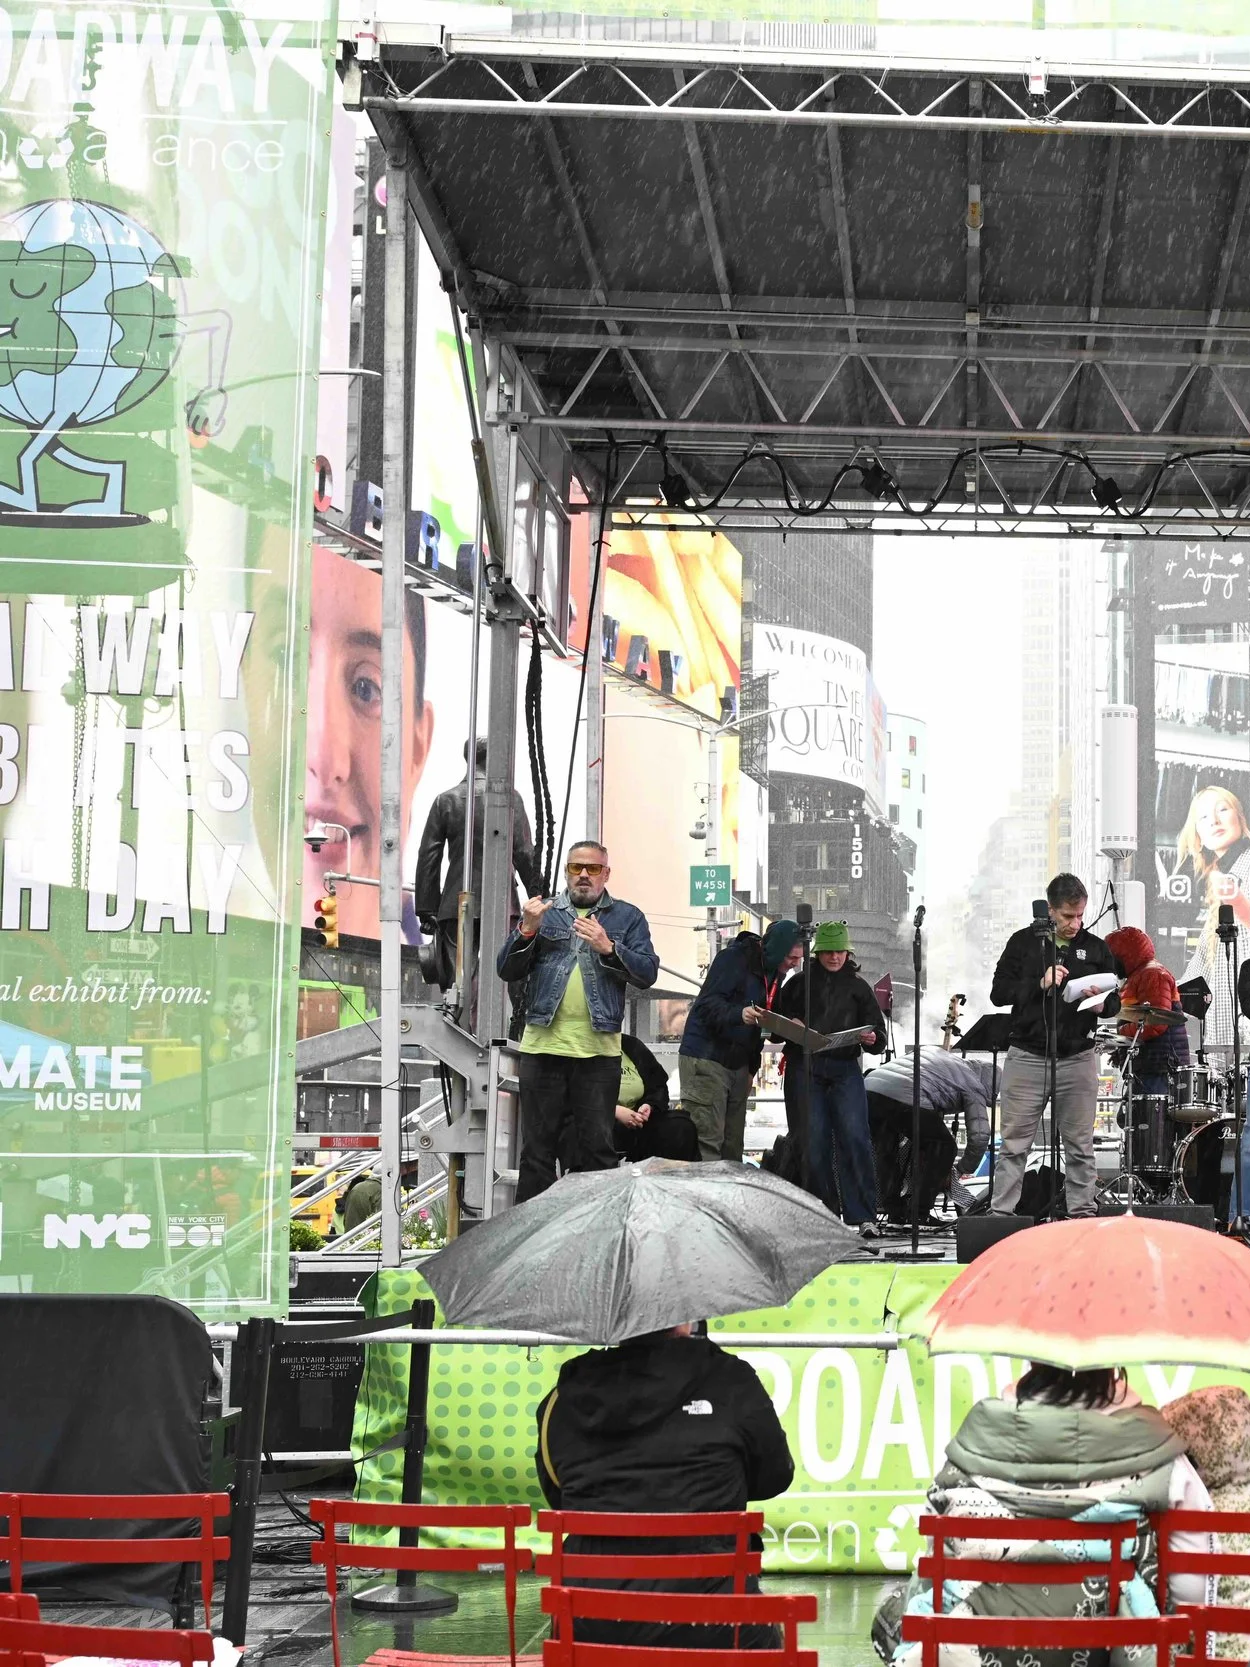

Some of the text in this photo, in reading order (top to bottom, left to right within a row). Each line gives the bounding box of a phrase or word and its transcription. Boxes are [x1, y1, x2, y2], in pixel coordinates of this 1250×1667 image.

[850, 823, 863, 879] 1500
[705, 869, 717, 878] TO
[694, 880, 726, 890] W 45 St
[29, 977, 130, 1003] exhibit
[130, 979, 212, 1010] from:
[34, 1092, 142, 1112] MUSEUM
[43, 1213, 152, 1249] NYC
[168, 1216, 185, 1224] NEW
[187, 1216, 208, 1224] YORK
[167, 1224, 225, 1248] DOT
